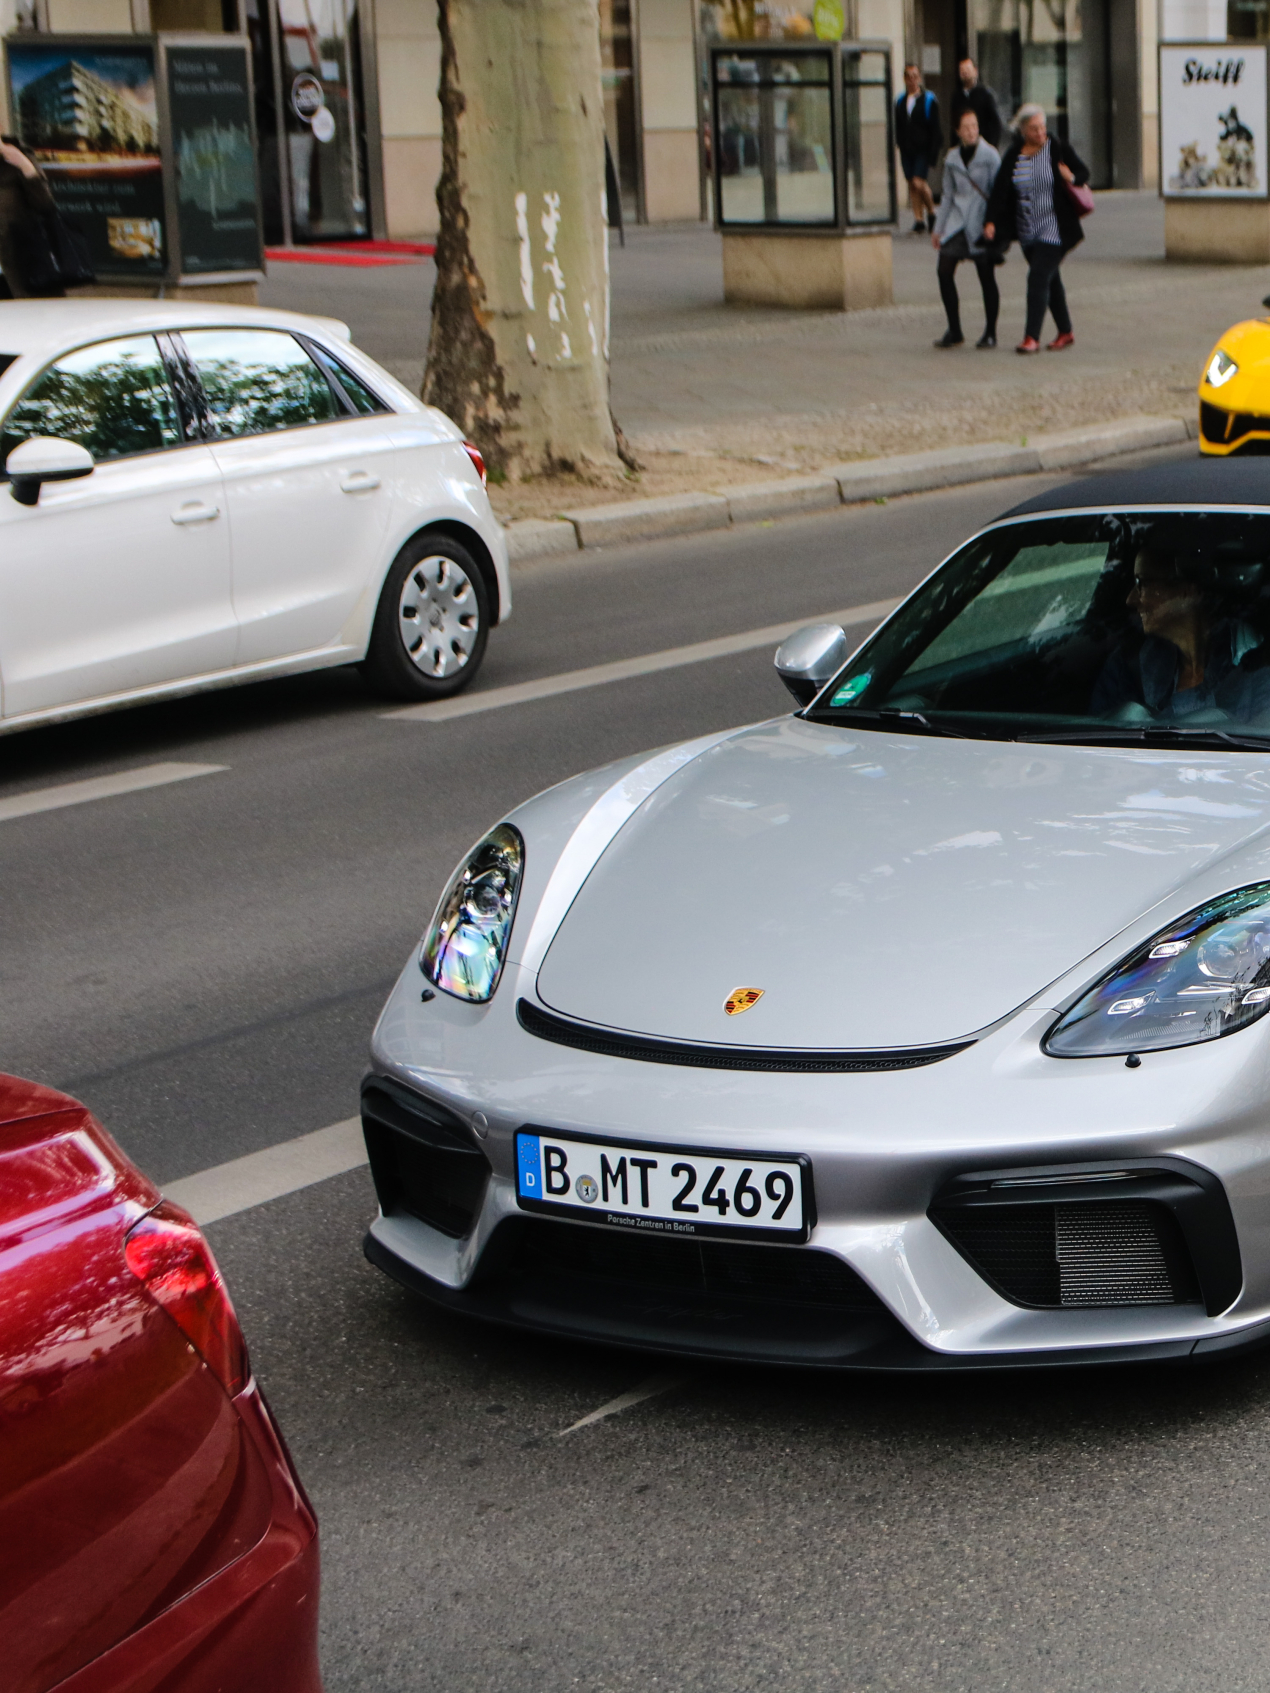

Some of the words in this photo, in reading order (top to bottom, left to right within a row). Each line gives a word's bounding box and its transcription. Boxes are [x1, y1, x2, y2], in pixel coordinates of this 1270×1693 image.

[1182, 57, 1245, 86] Steiff
[525, 1171, 536, 1187] D
[543, 1144, 571, 1196] B
[600, 1152, 658, 1208] MT
[671, 1161, 795, 1221] 2469
[607, 1213, 635, 1226] Porsche
[635, 1217, 664, 1230] Zentren
[664, 1221, 672, 1230] in
[673, 1222, 696, 1233] Berlin
